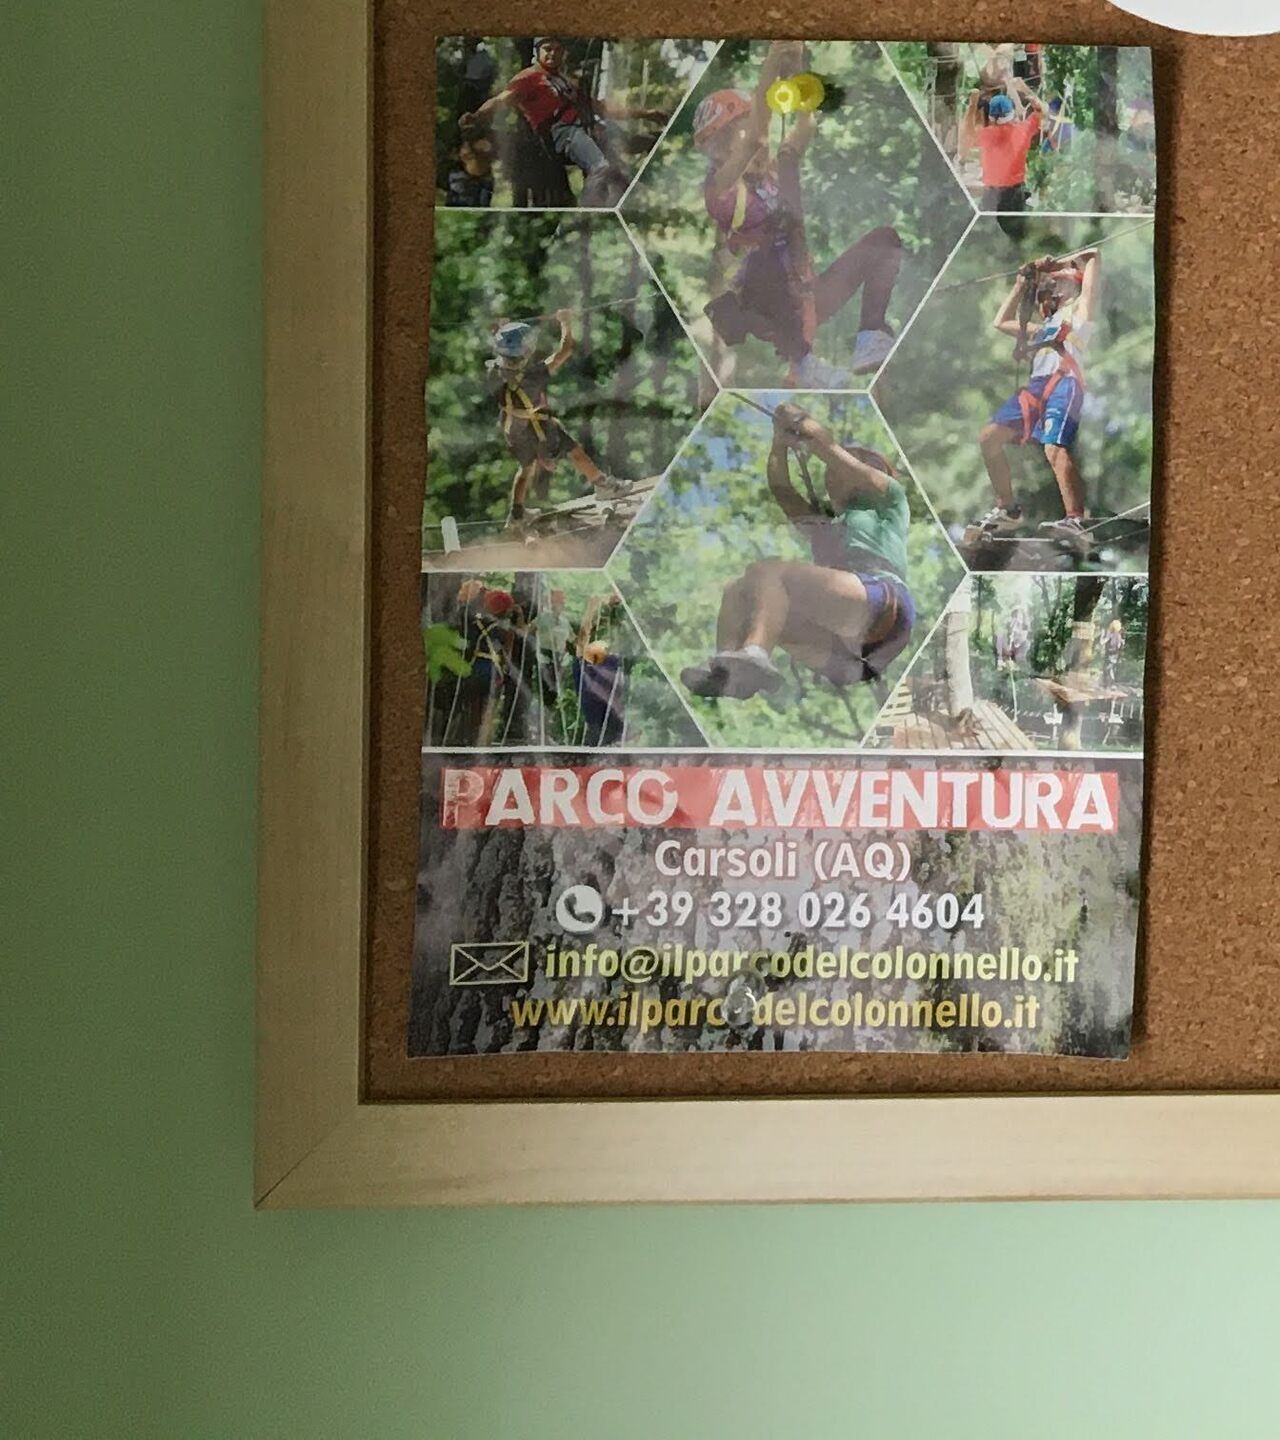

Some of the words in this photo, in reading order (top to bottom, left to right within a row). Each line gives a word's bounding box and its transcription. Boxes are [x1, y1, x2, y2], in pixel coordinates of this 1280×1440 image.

[442, 768, 679, 826] PARCO
[708, 769, 1114, 831] AVVENTURA
[655, 840, 797, 878] Carsoli
[814, 841, 912, 881] (AQ)
[611, 891, 694, 927] +39
[710, 891, 783, 928] 328
[798, 892, 872, 929] 026
[886, 893, 985, 930] 4604
[511, 991, 1040, 1034] www.ilparcdelcolonnello.it
